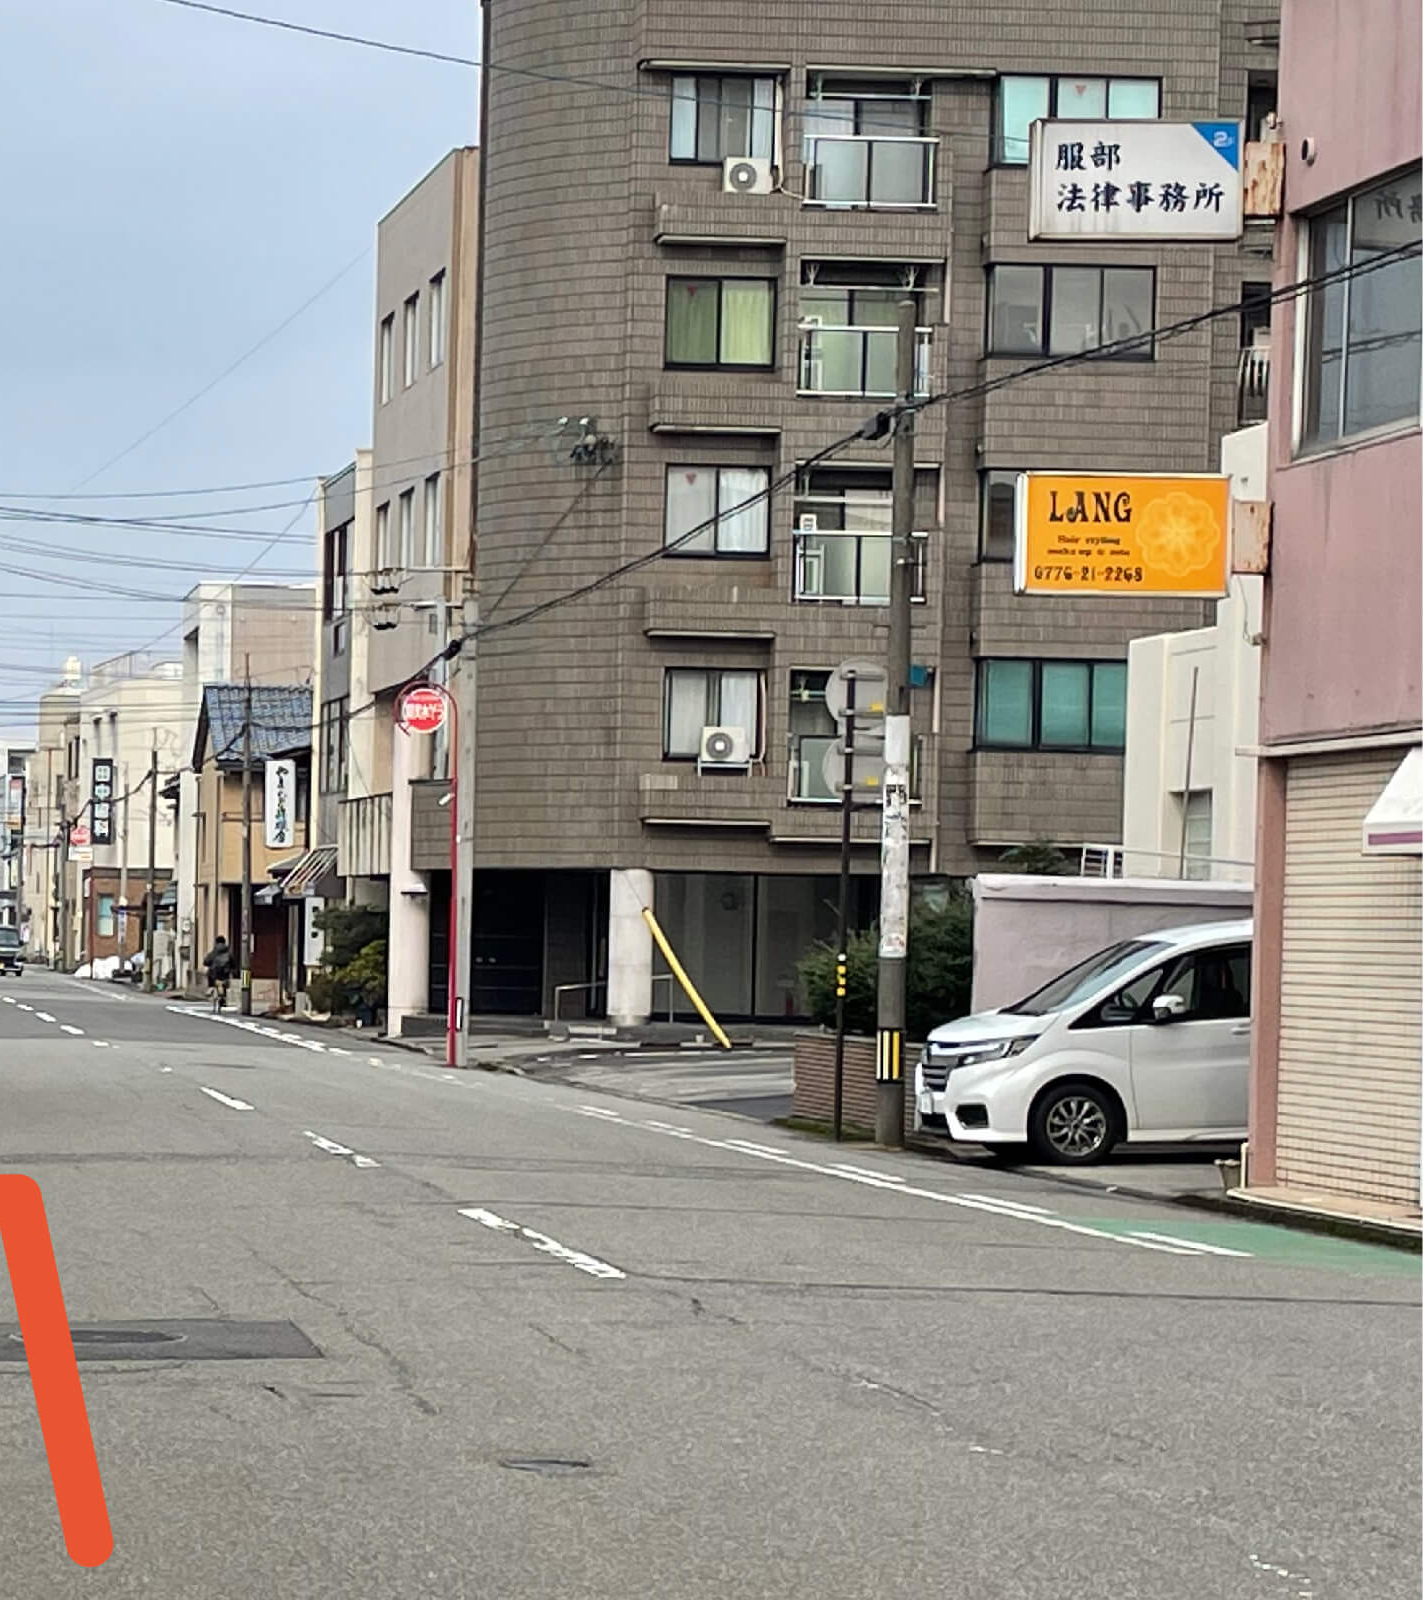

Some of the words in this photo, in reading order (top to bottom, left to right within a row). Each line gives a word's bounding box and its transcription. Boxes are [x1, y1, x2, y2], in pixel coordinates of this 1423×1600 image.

[1055, 142, 1121, 171] 服部
[1056, 181, 1226, 214] 法律事務所
[1049, 490, 1132, 523] LANG
[1034, 566, 1142, 582] 0776-21-2268
